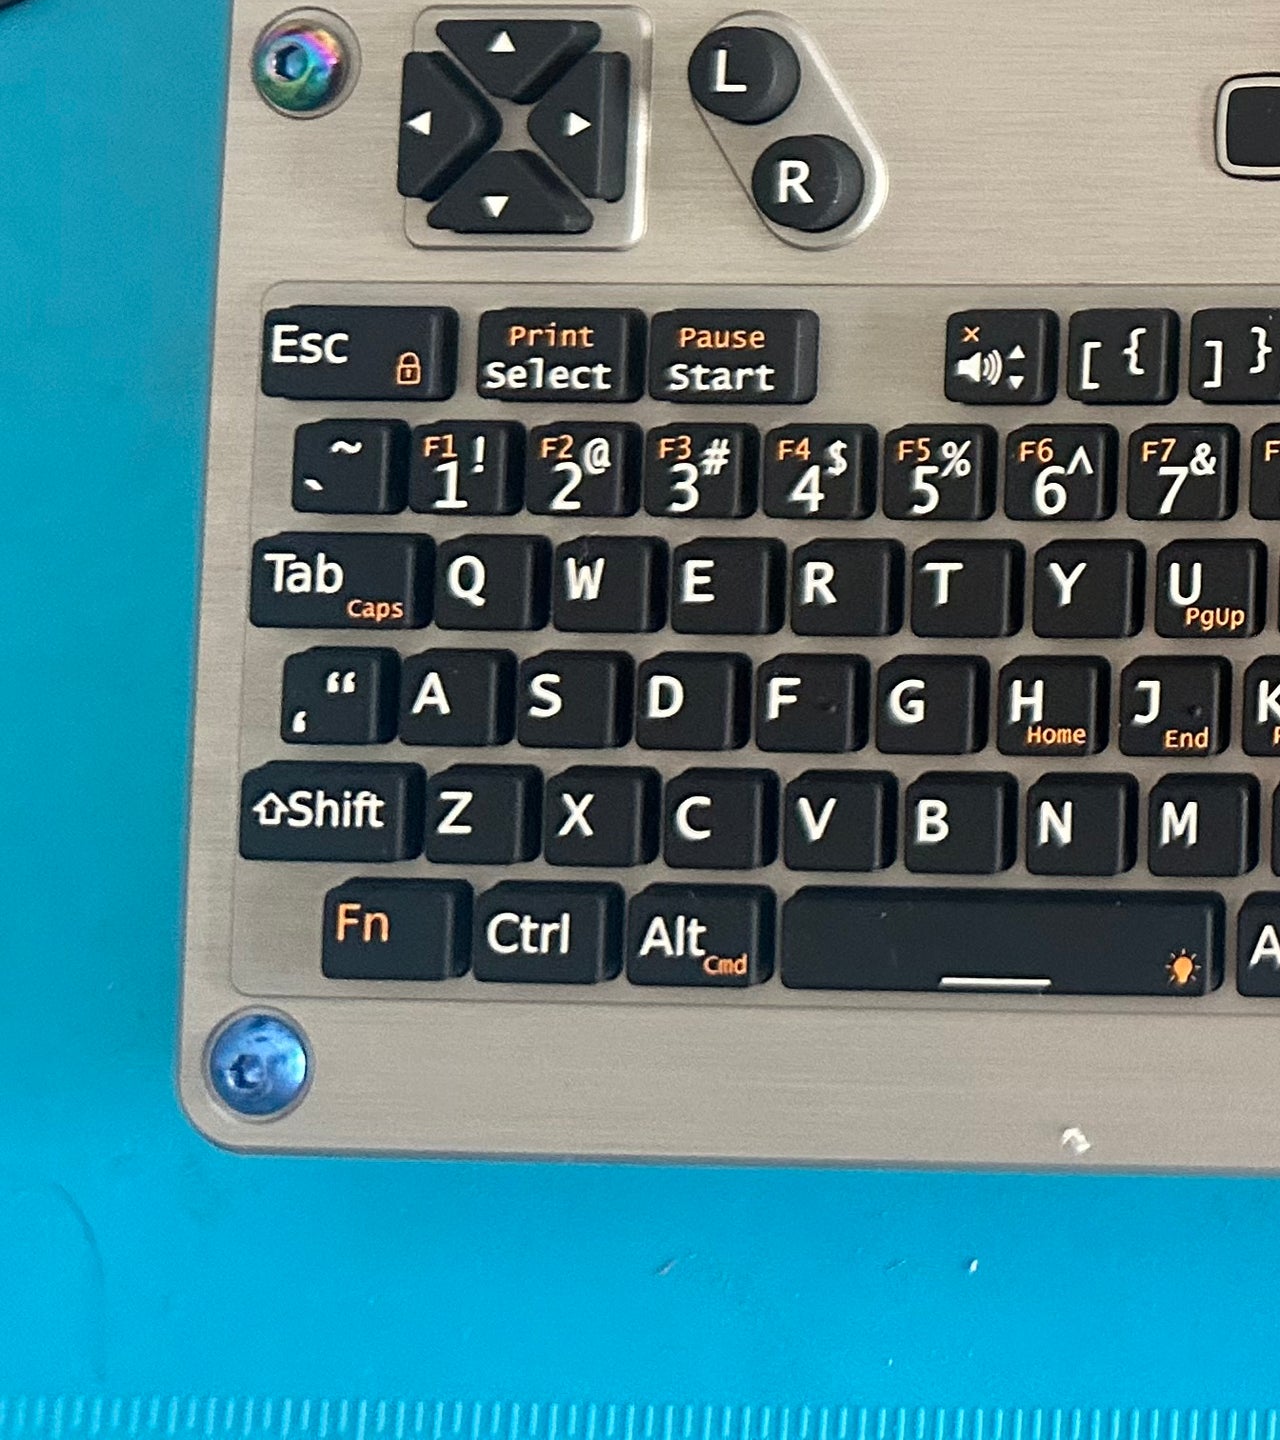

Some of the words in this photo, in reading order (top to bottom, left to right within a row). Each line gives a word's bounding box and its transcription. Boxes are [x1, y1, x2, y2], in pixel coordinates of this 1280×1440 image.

[711, 49, 746, 92] L
[775, 160, 814, 203] R
[271, 324, 349, 363] Esc
[509, 321, 594, 347] Print
[680, 327, 765, 349] Pause
[485, 357, 612, 390] Select
[669, 363, 775, 392] Start
[424, 434, 458, 458] F1
[471, 435, 486, 474] !
[541, 435, 573, 459] F2
[582, 437, 611, 475] @
[659, 436, 692, 460] F3
[700, 438, 731, 475] #
[777, 437, 811, 461] F4
[826, 440, 848, 476] $
[899, 437, 930, 461] F5
[939, 440, 971, 477] %
[1019, 438, 1053, 462] F6
[1066, 445, 1094, 475] ^
[1141, 438, 1177, 462] F7
[1189, 442, 1216, 475] &
[433, 461, 468, 509] 1
[550, 461, 582, 510] 2
[669, 462, 699, 512] 3
[789, 465, 825, 513] 4
[911, 465, 940, 514] 5
[1034, 465, 1067, 515] 6
[1158, 466, 1189, 515] 7
[264, 553, 343, 593] Tab
[447, 555, 486, 606] Q
[566, 557, 605, 601] W
[684, 560, 715, 603] E
[804, 562, 836, 604] R
[923, 563, 963, 606] T
[1050, 563, 1087, 606] Y
[1169, 562, 1202, 606] U
[346, 599, 404, 622] Caps
[1185, 607, 1245, 630] PgUp
[410, 672, 450, 715] A
[528, 673, 563, 717] S
[648, 675, 684, 718] D
[767, 677, 801, 720] F
[890, 679, 925, 724] G
[1009, 679, 1044, 723] H
[1133, 680, 1161, 726] J
[1026, 726, 1087, 745] Home
[1164, 727, 1209, 749] End
[287, 790, 385, 828] Shift
[436, 791, 473, 834] Z
[557, 792, 595, 837] X
[675, 796, 711, 840] C
[798, 797, 836, 842] V
[914, 799, 949, 843] B
[1037, 800, 1072, 847] N
[1159, 801, 1198, 848] M
[335, 902, 390, 943] Fn
[486, 912, 571, 955] Ctrl
[638, 915, 707, 958] Alt
[702, 953, 748, 976] Cmd
